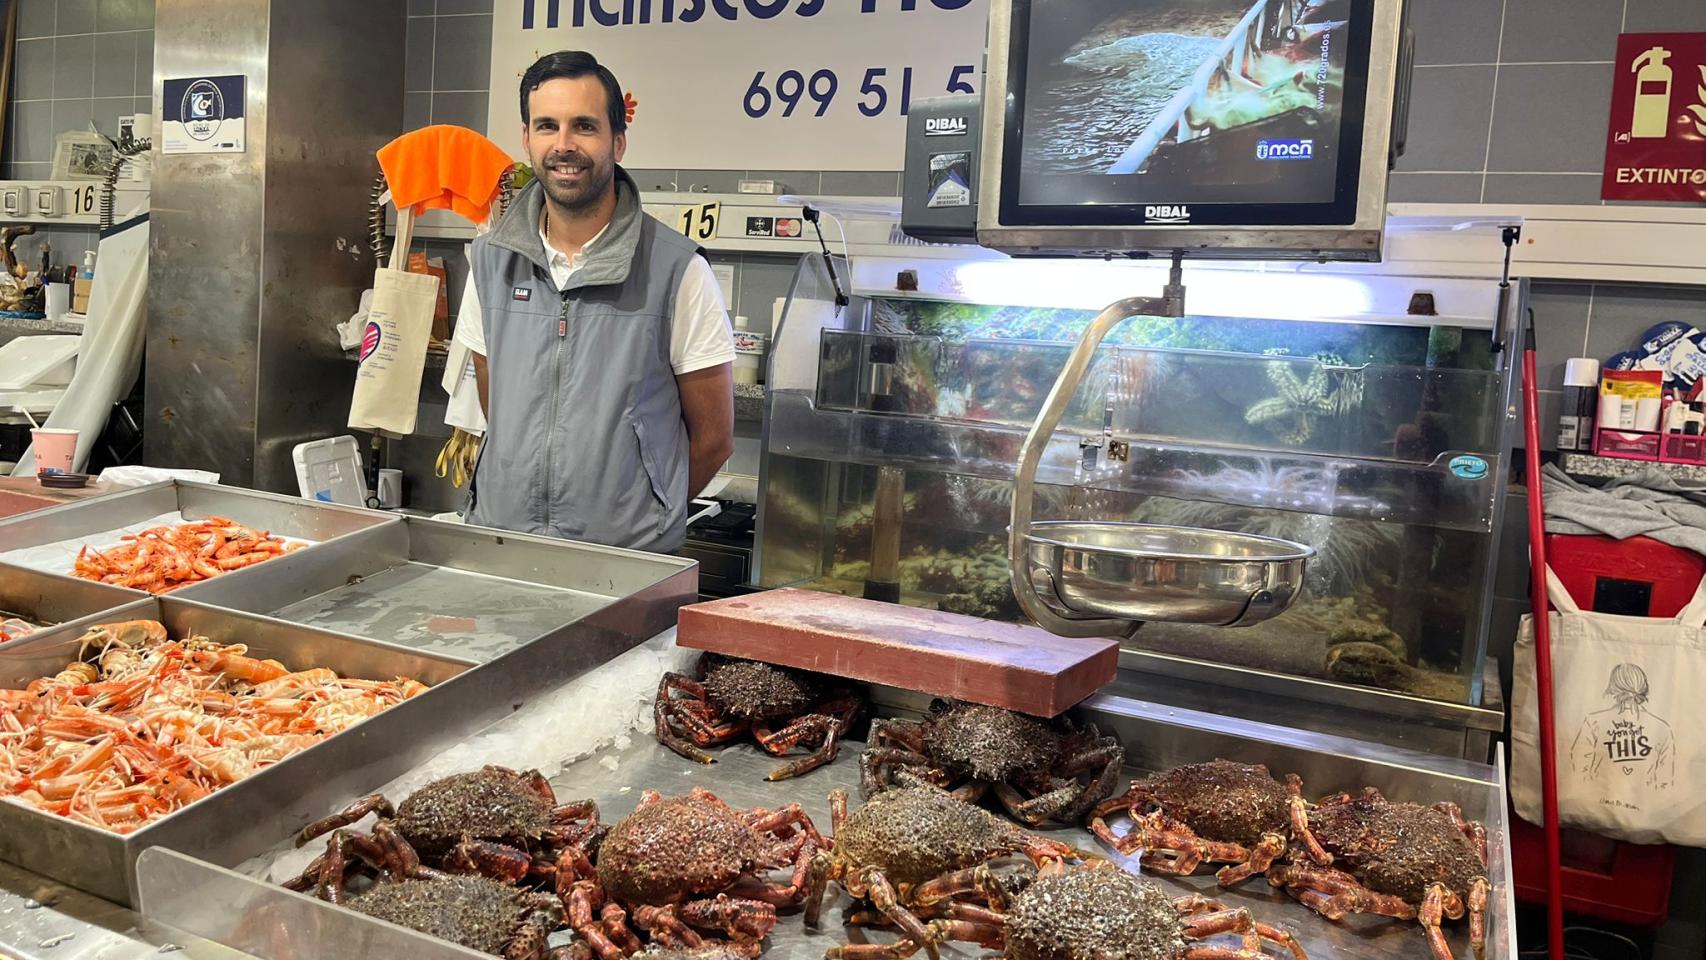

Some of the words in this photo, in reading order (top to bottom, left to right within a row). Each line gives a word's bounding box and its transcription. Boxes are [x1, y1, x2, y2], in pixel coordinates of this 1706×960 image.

[743, 69, 838, 118] 699
[925, 117, 967, 130] DIBAL
[1615, 167, 1706, 184] EXTINTO
[74, 185, 94, 214] 16
[683, 203, 716, 238] 15
[1144, 205, 1190, 218] DIBAL
[1603, 736, 1653, 759] THIS
